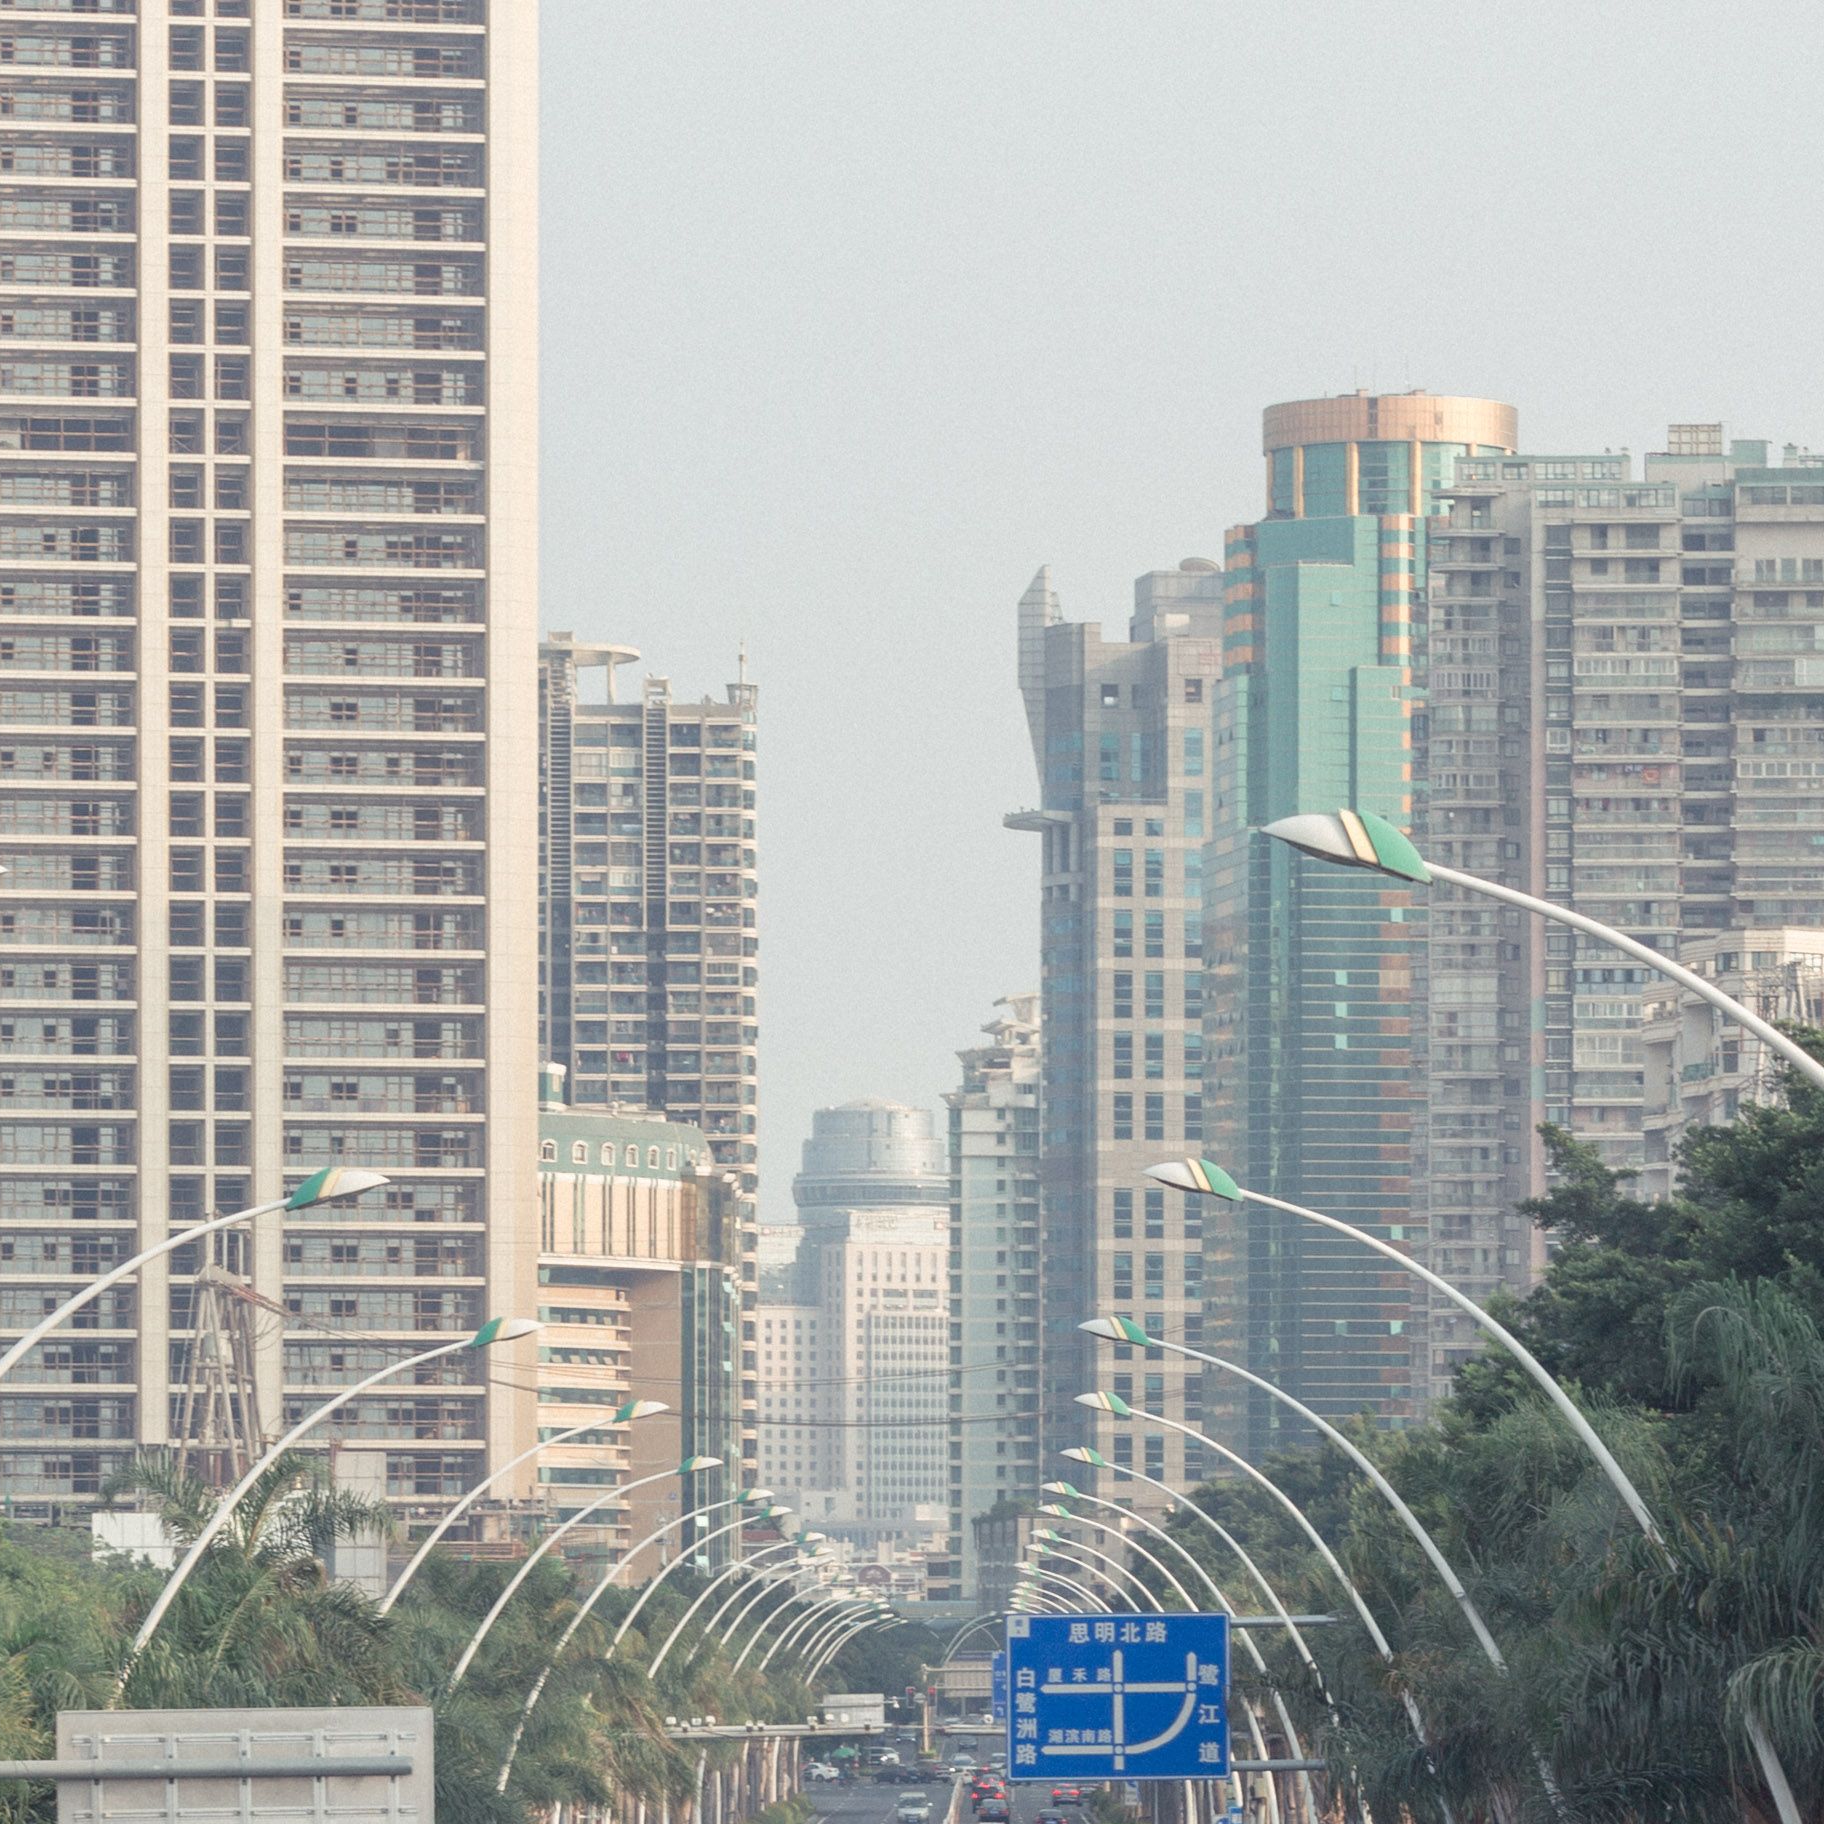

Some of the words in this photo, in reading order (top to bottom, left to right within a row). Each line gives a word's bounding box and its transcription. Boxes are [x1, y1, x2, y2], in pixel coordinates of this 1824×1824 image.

[1068, 1622, 1168, 1643] 思明北路
[1047, 1668, 1112, 1682] 厦禾路
[1015, 1668, 1038, 1765] 白鹭洲路
[1198, 1664, 1221, 1763] 鹭江道
[1048, 1729, 1113, 1744] 湖滨南路
